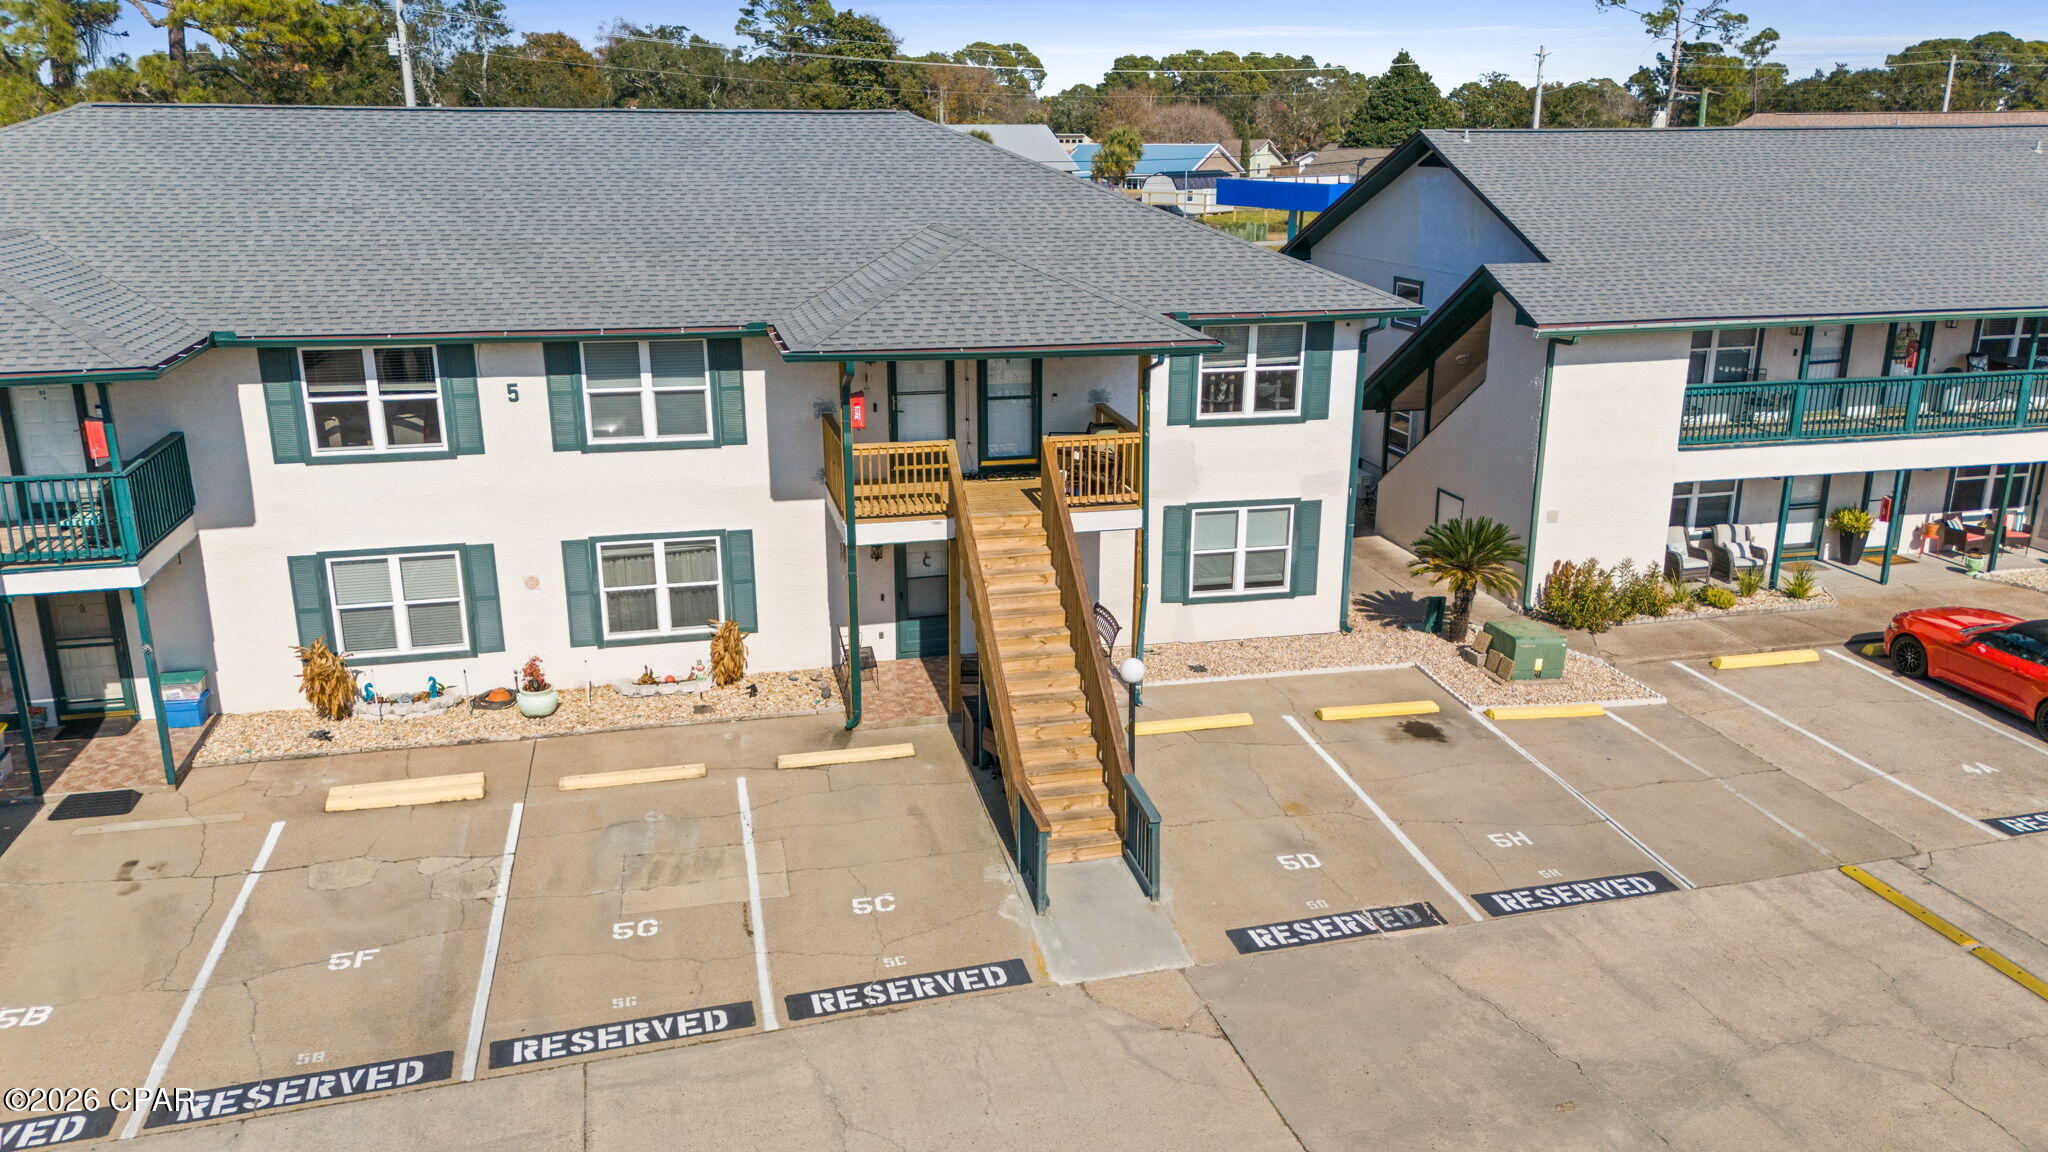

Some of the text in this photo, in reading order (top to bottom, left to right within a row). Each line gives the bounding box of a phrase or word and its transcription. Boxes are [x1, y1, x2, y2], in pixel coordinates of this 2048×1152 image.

[507, 383, 519, 402] 5
[923, 556, 931, 566] C
[1962, 762, 1999, 774] 4A
[1488, 832, 1533, 848] 5H
[1276, 853, 1322, 871] 5D
[852, 893, 896, 915] 5C
[1491, 876, 1656, 912] RESERVED
[612, 919, 662, 940] 5G
[1246, 908, 1421, 949] RESERVED
[327, 948, 380, 970] 5F
[812, 966, 1008, 1015] RESERVED
[0, 1005, 54, 1029] 5B
[513, 1009, 729, 1064] RESERVED
[177, 1060, 425, 1121] RESERVED
